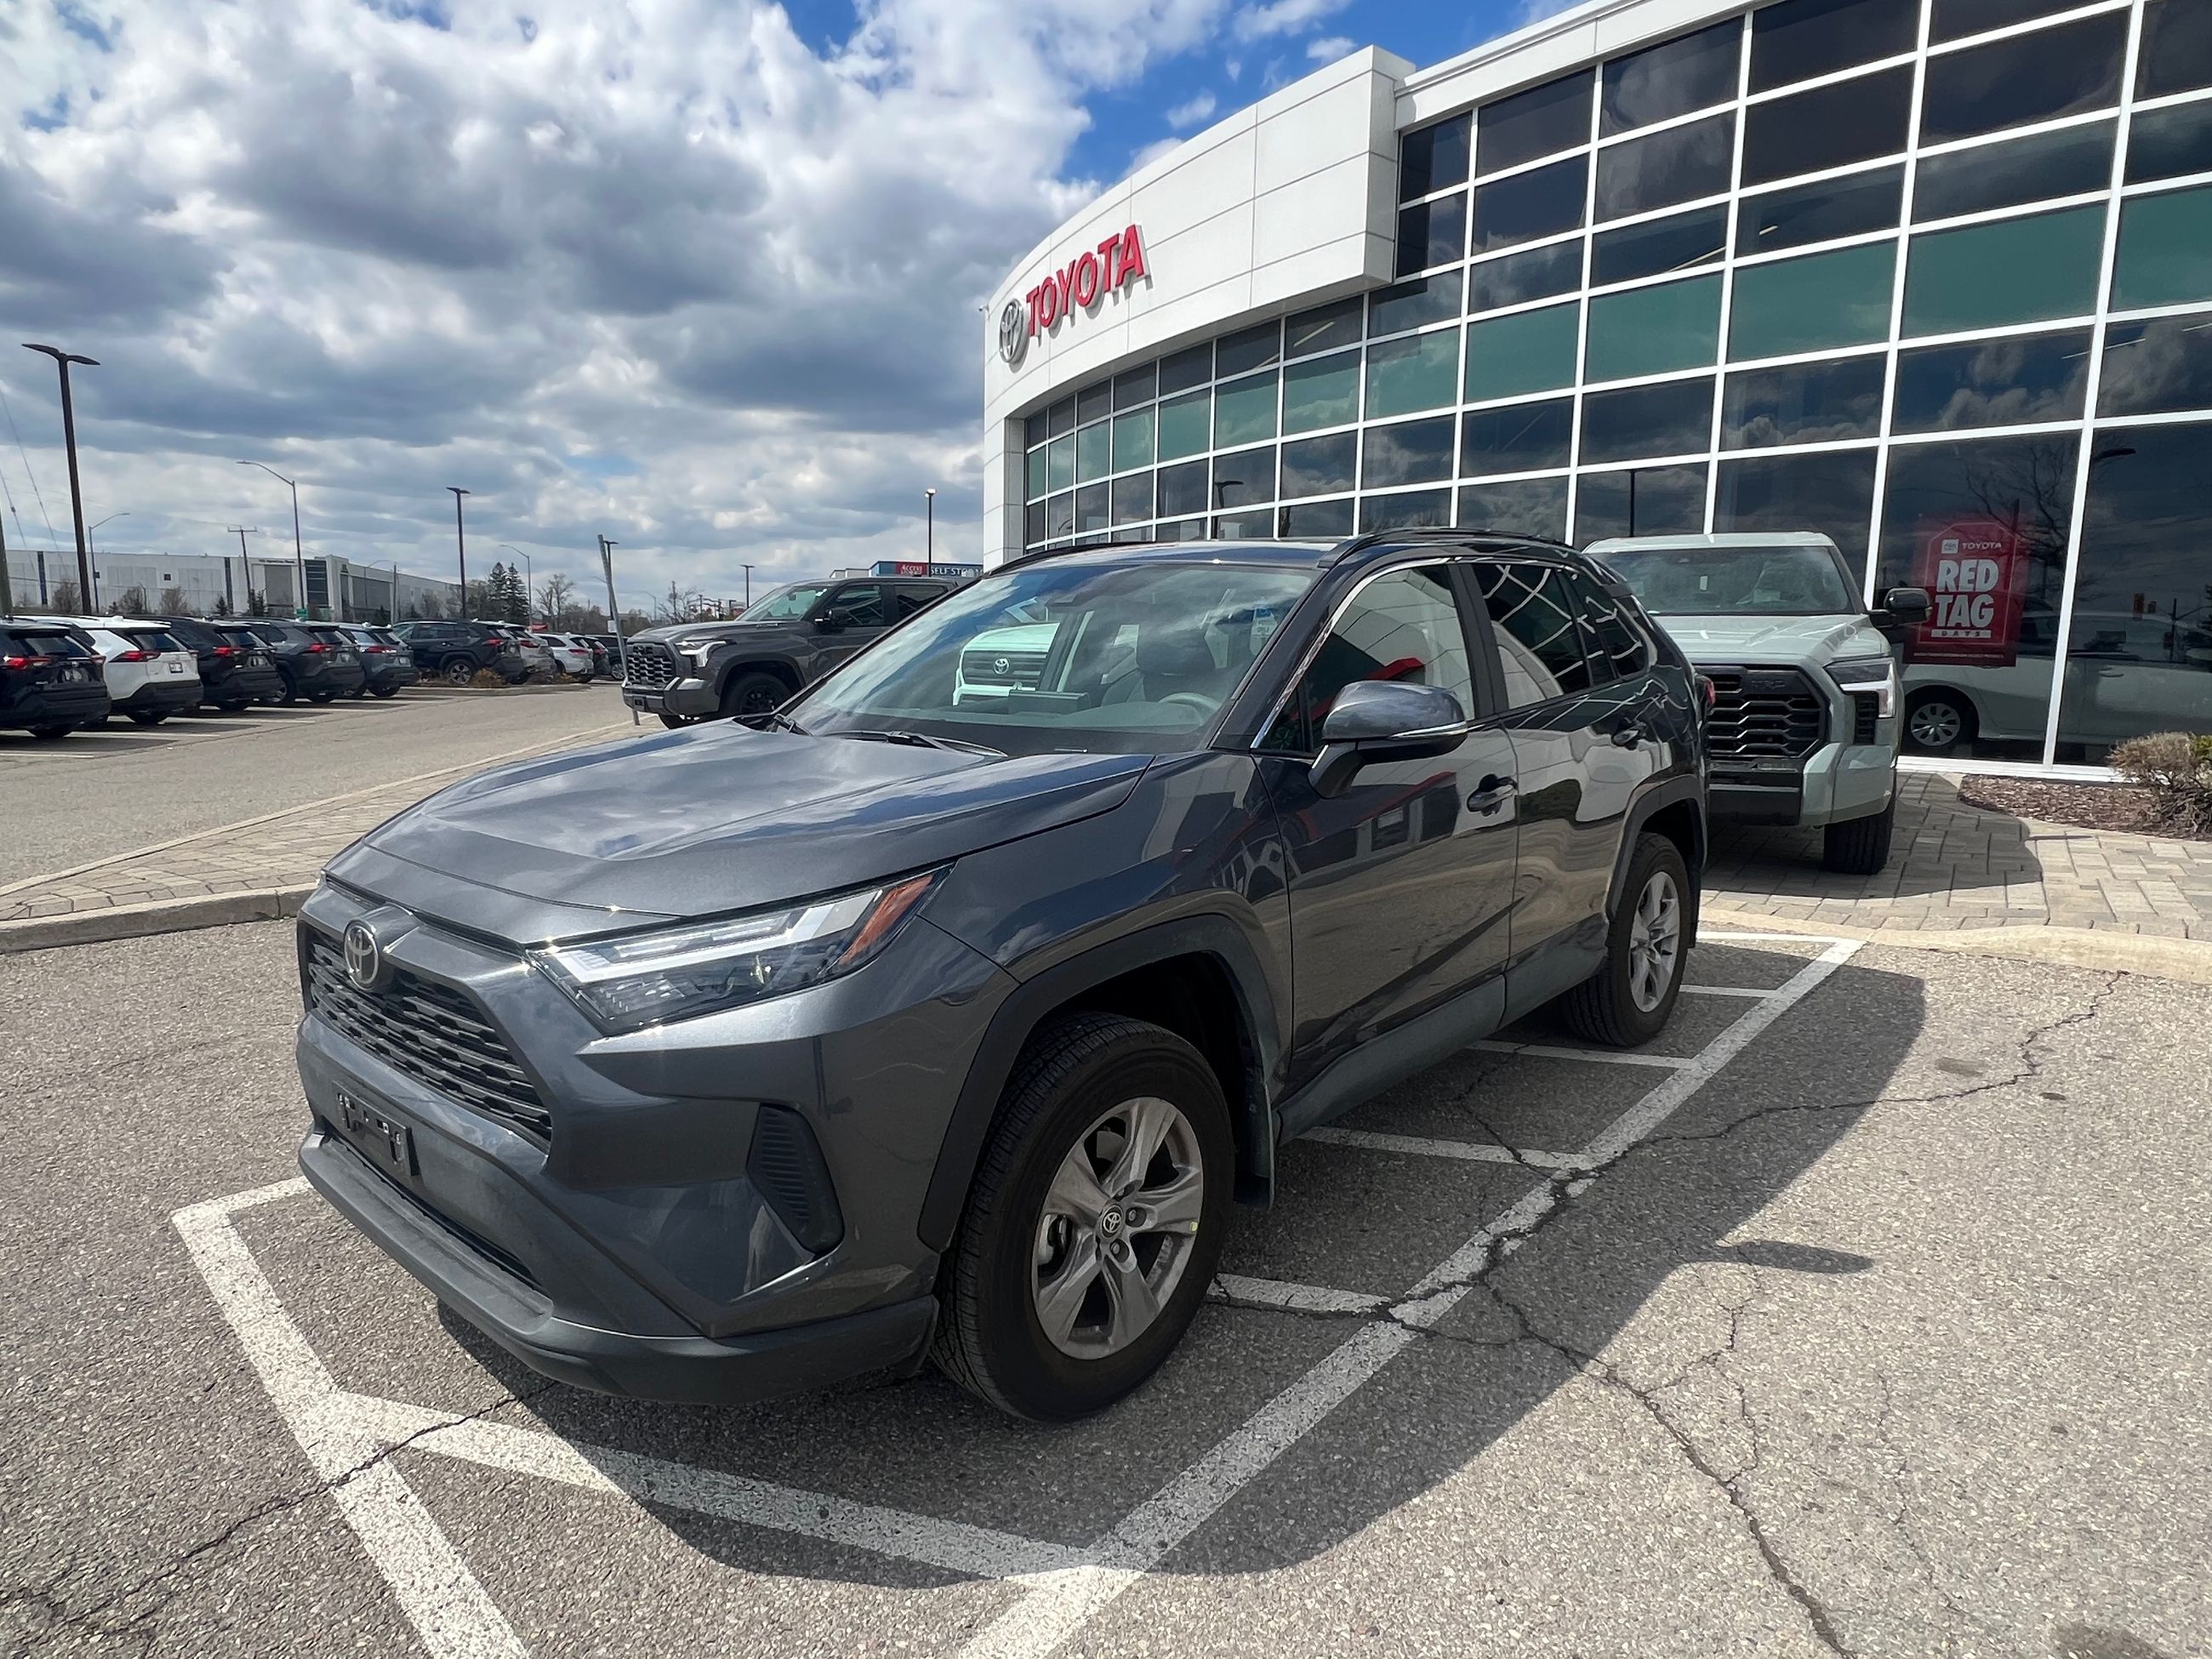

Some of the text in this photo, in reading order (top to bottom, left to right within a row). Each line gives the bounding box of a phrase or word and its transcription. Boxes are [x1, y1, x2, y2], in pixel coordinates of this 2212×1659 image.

[1026, 224, 1146, 337] TOYOTA
[931, 567, 950, 575] SELF
[1936, 560, 1999, 592] RED
[1935, 594, 1993, 628] TAG
